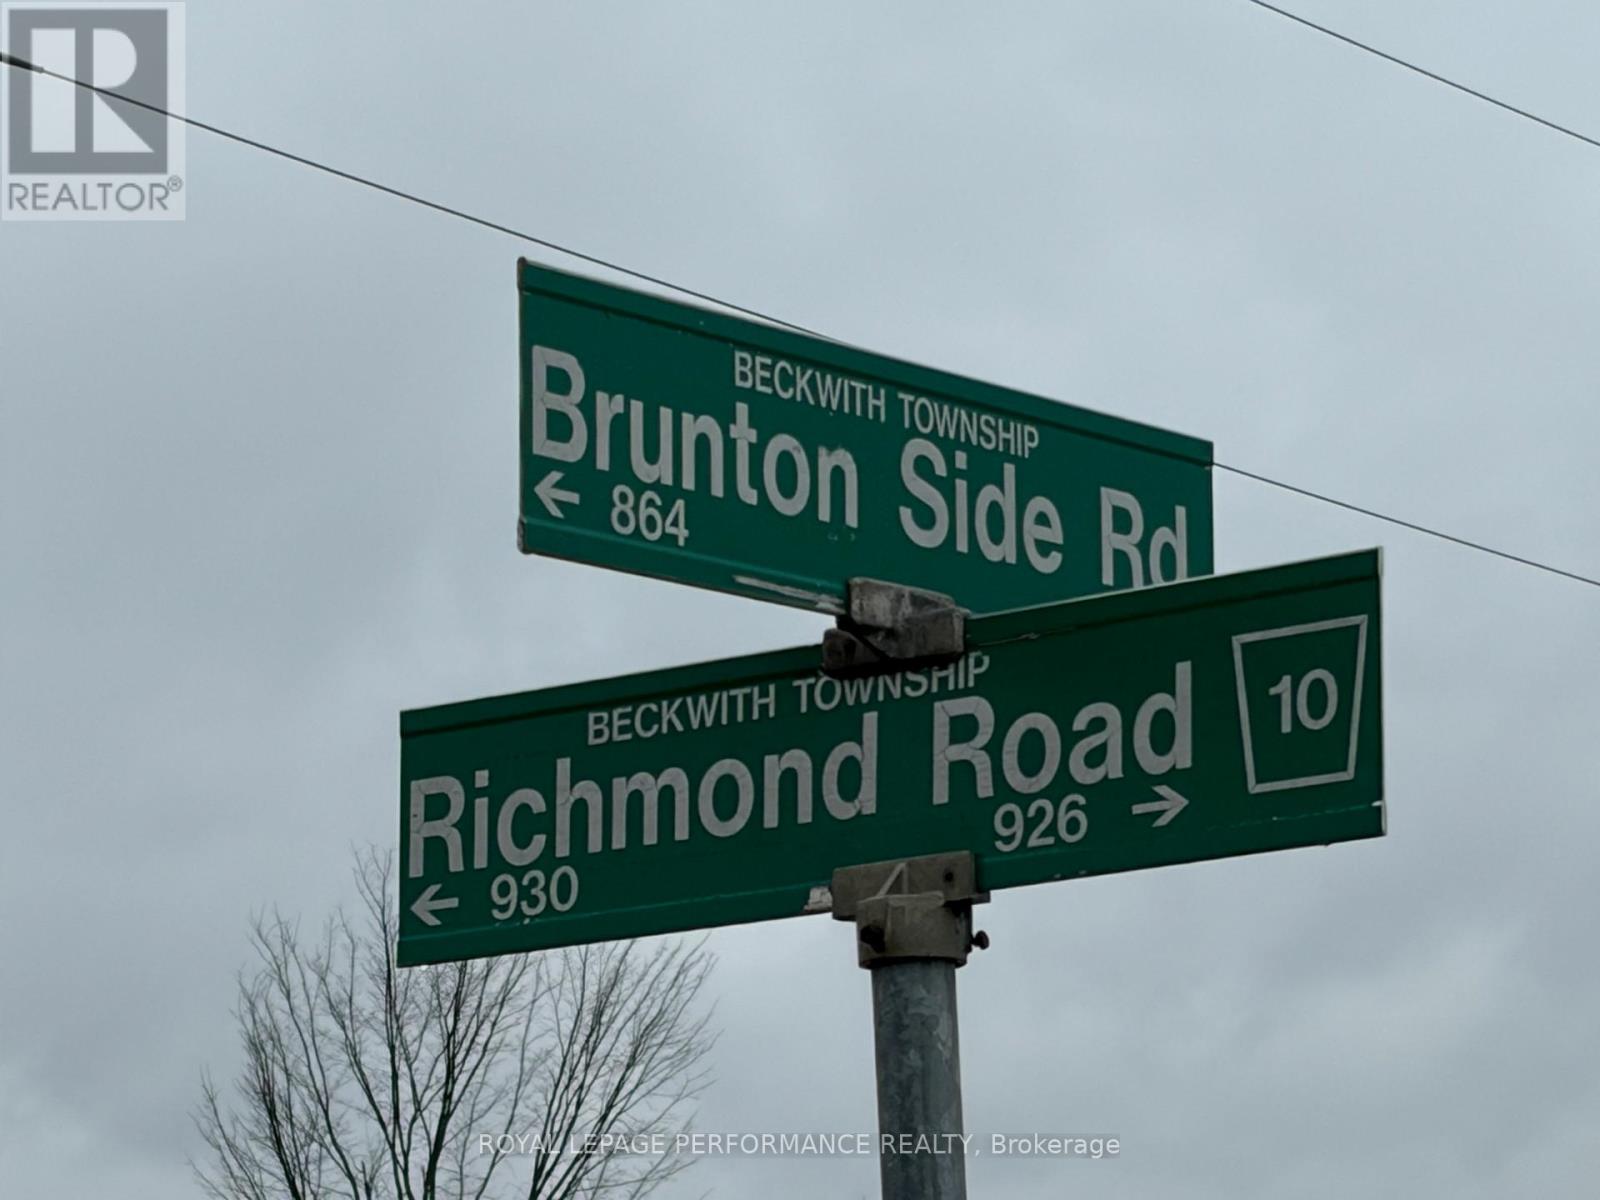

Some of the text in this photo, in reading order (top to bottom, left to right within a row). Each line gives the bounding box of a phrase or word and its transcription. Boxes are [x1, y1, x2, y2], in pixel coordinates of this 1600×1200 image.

[734, 349, 1039, 459] BECKWITH TOWNSHIP
[531, 344, 1188, 589] Brunton Side Rd
[610, 483, 690, 547] 864
[587, 651, 991, 746] BECKWITH TOWNSHIP
[1267, 667, 1339, 734] 10
[408, 660, 1193, 879] Richmond Road
[993, 792, 1089, 852] 926
[490, 864, 580, 921] 930
